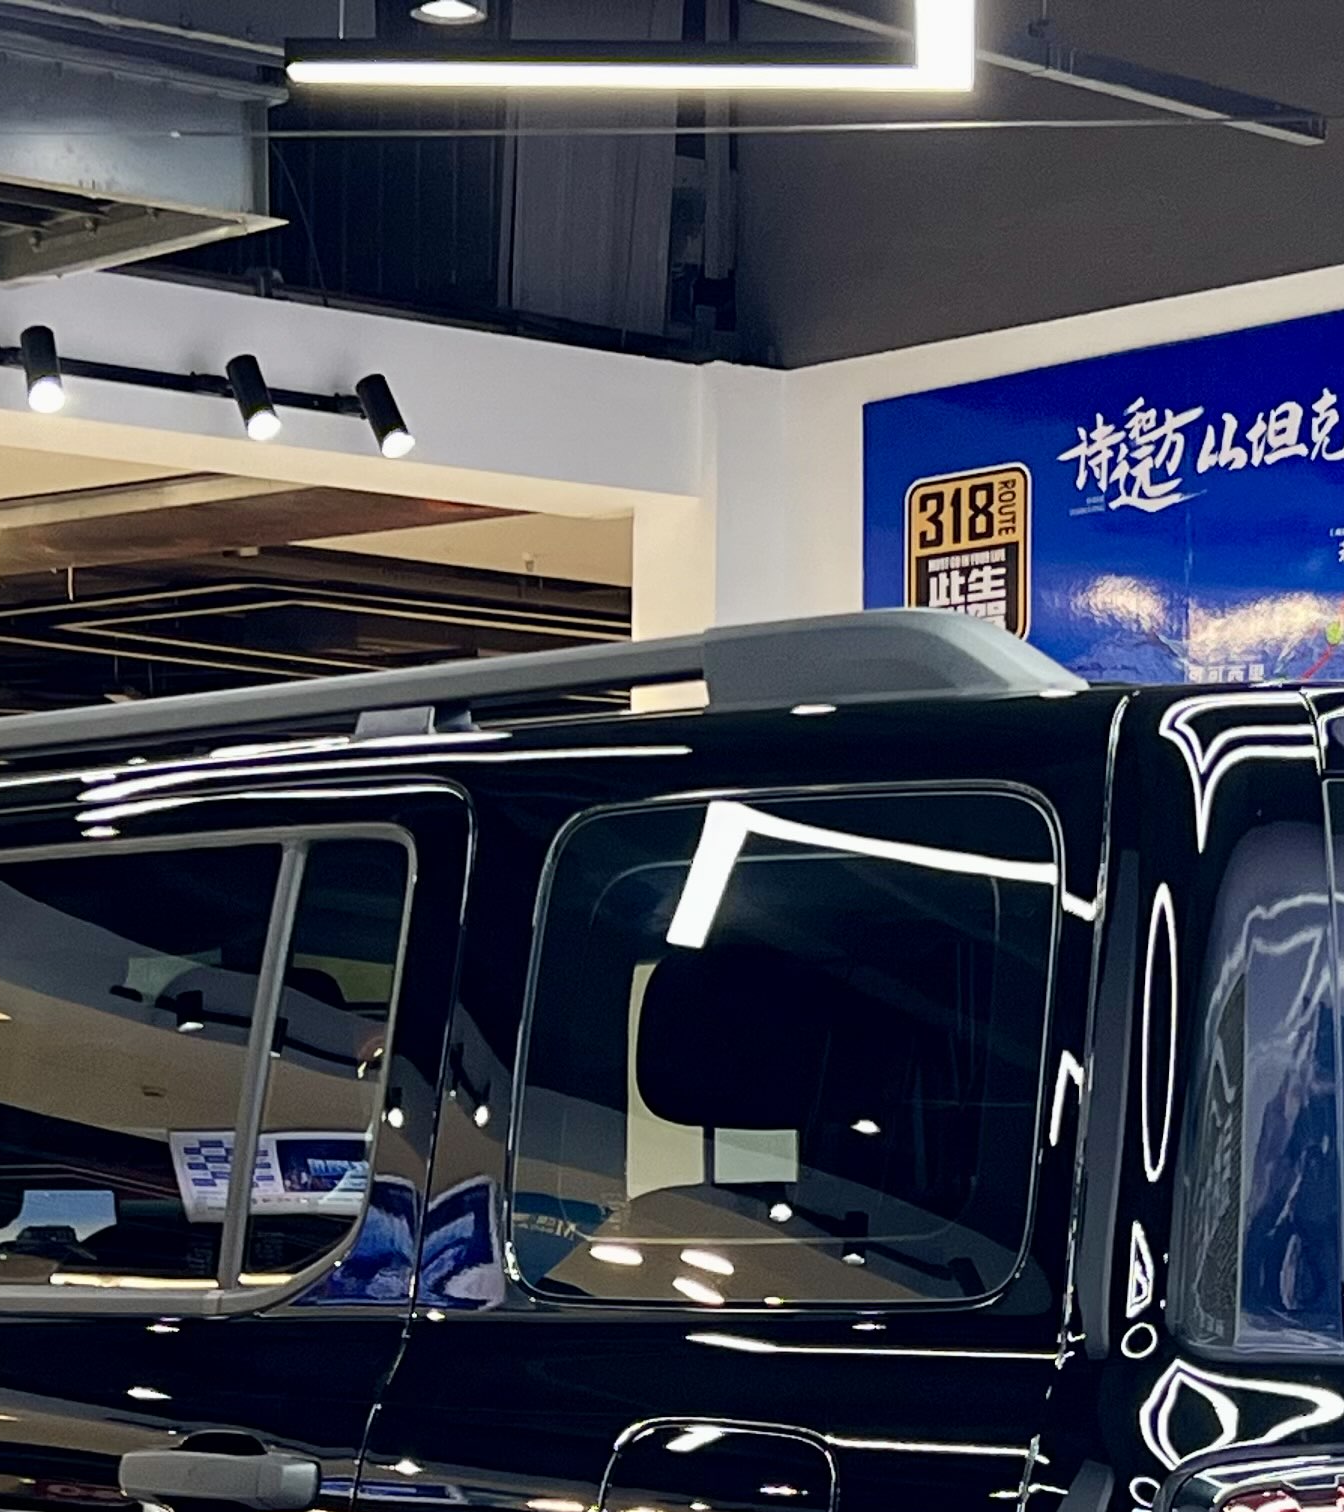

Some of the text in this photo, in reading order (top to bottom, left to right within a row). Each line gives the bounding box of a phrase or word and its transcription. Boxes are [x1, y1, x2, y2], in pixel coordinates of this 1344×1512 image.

[918, 482, 995, 550] 318
[997, 478, 1017, 537] ROUTE
[928, 564, 1007, 608] 此生
